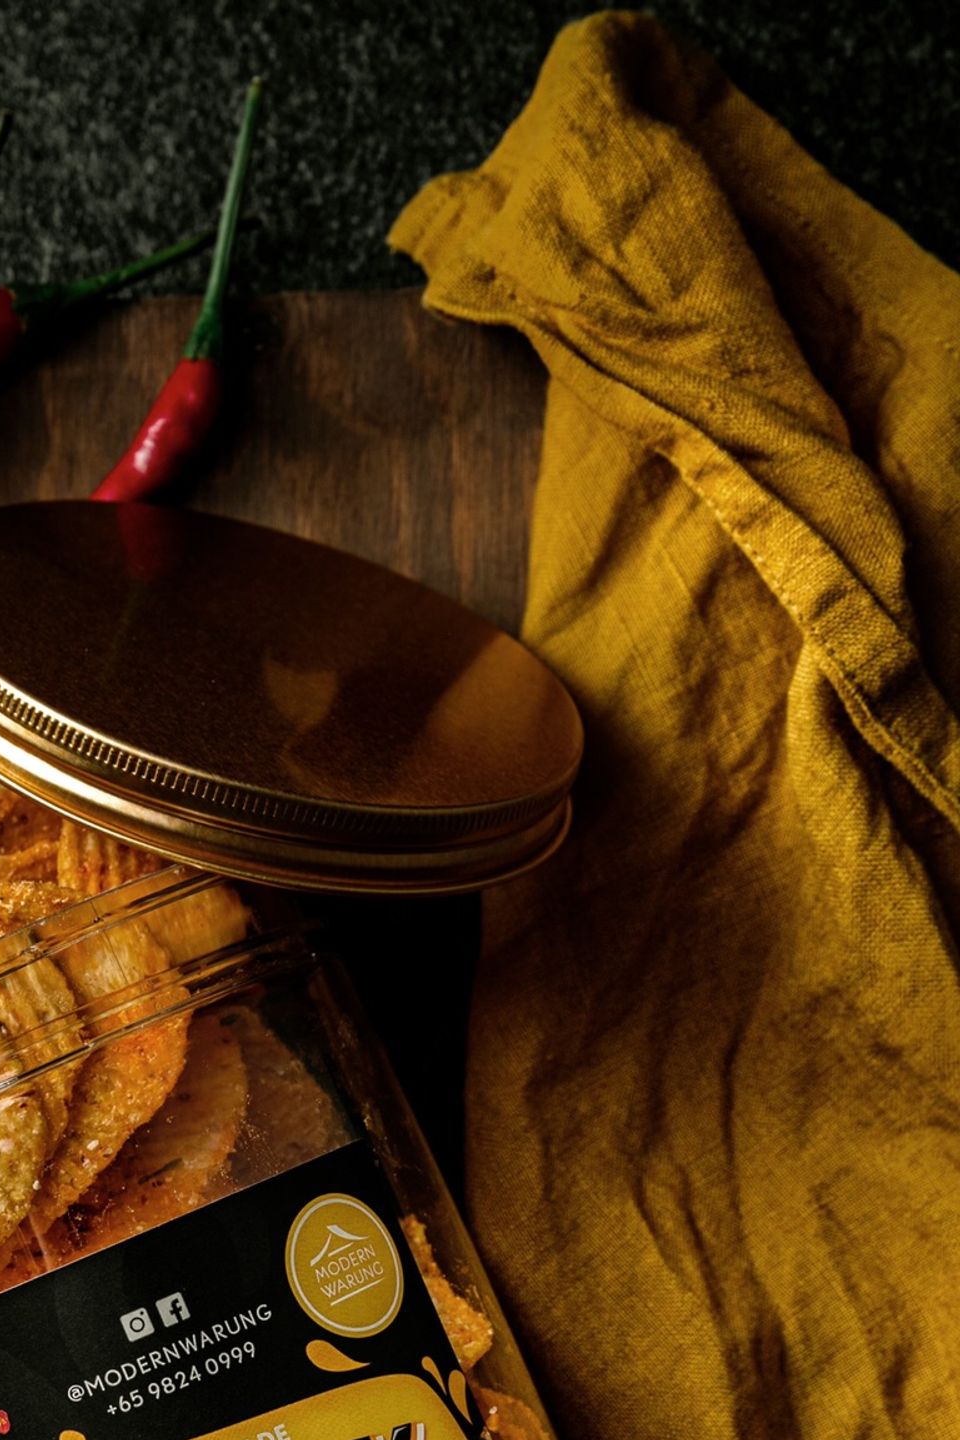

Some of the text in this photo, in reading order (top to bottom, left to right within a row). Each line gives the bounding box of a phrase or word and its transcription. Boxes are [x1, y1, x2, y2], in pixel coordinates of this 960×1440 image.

[315, 1244, 376, 1283] MODERN
[320, 1261, 384, 1298] WARUNG
[67, 1303, 273, 1402] @MODERNWARUNG
[106, 1341, 257, 1416] +65 9824 0999
